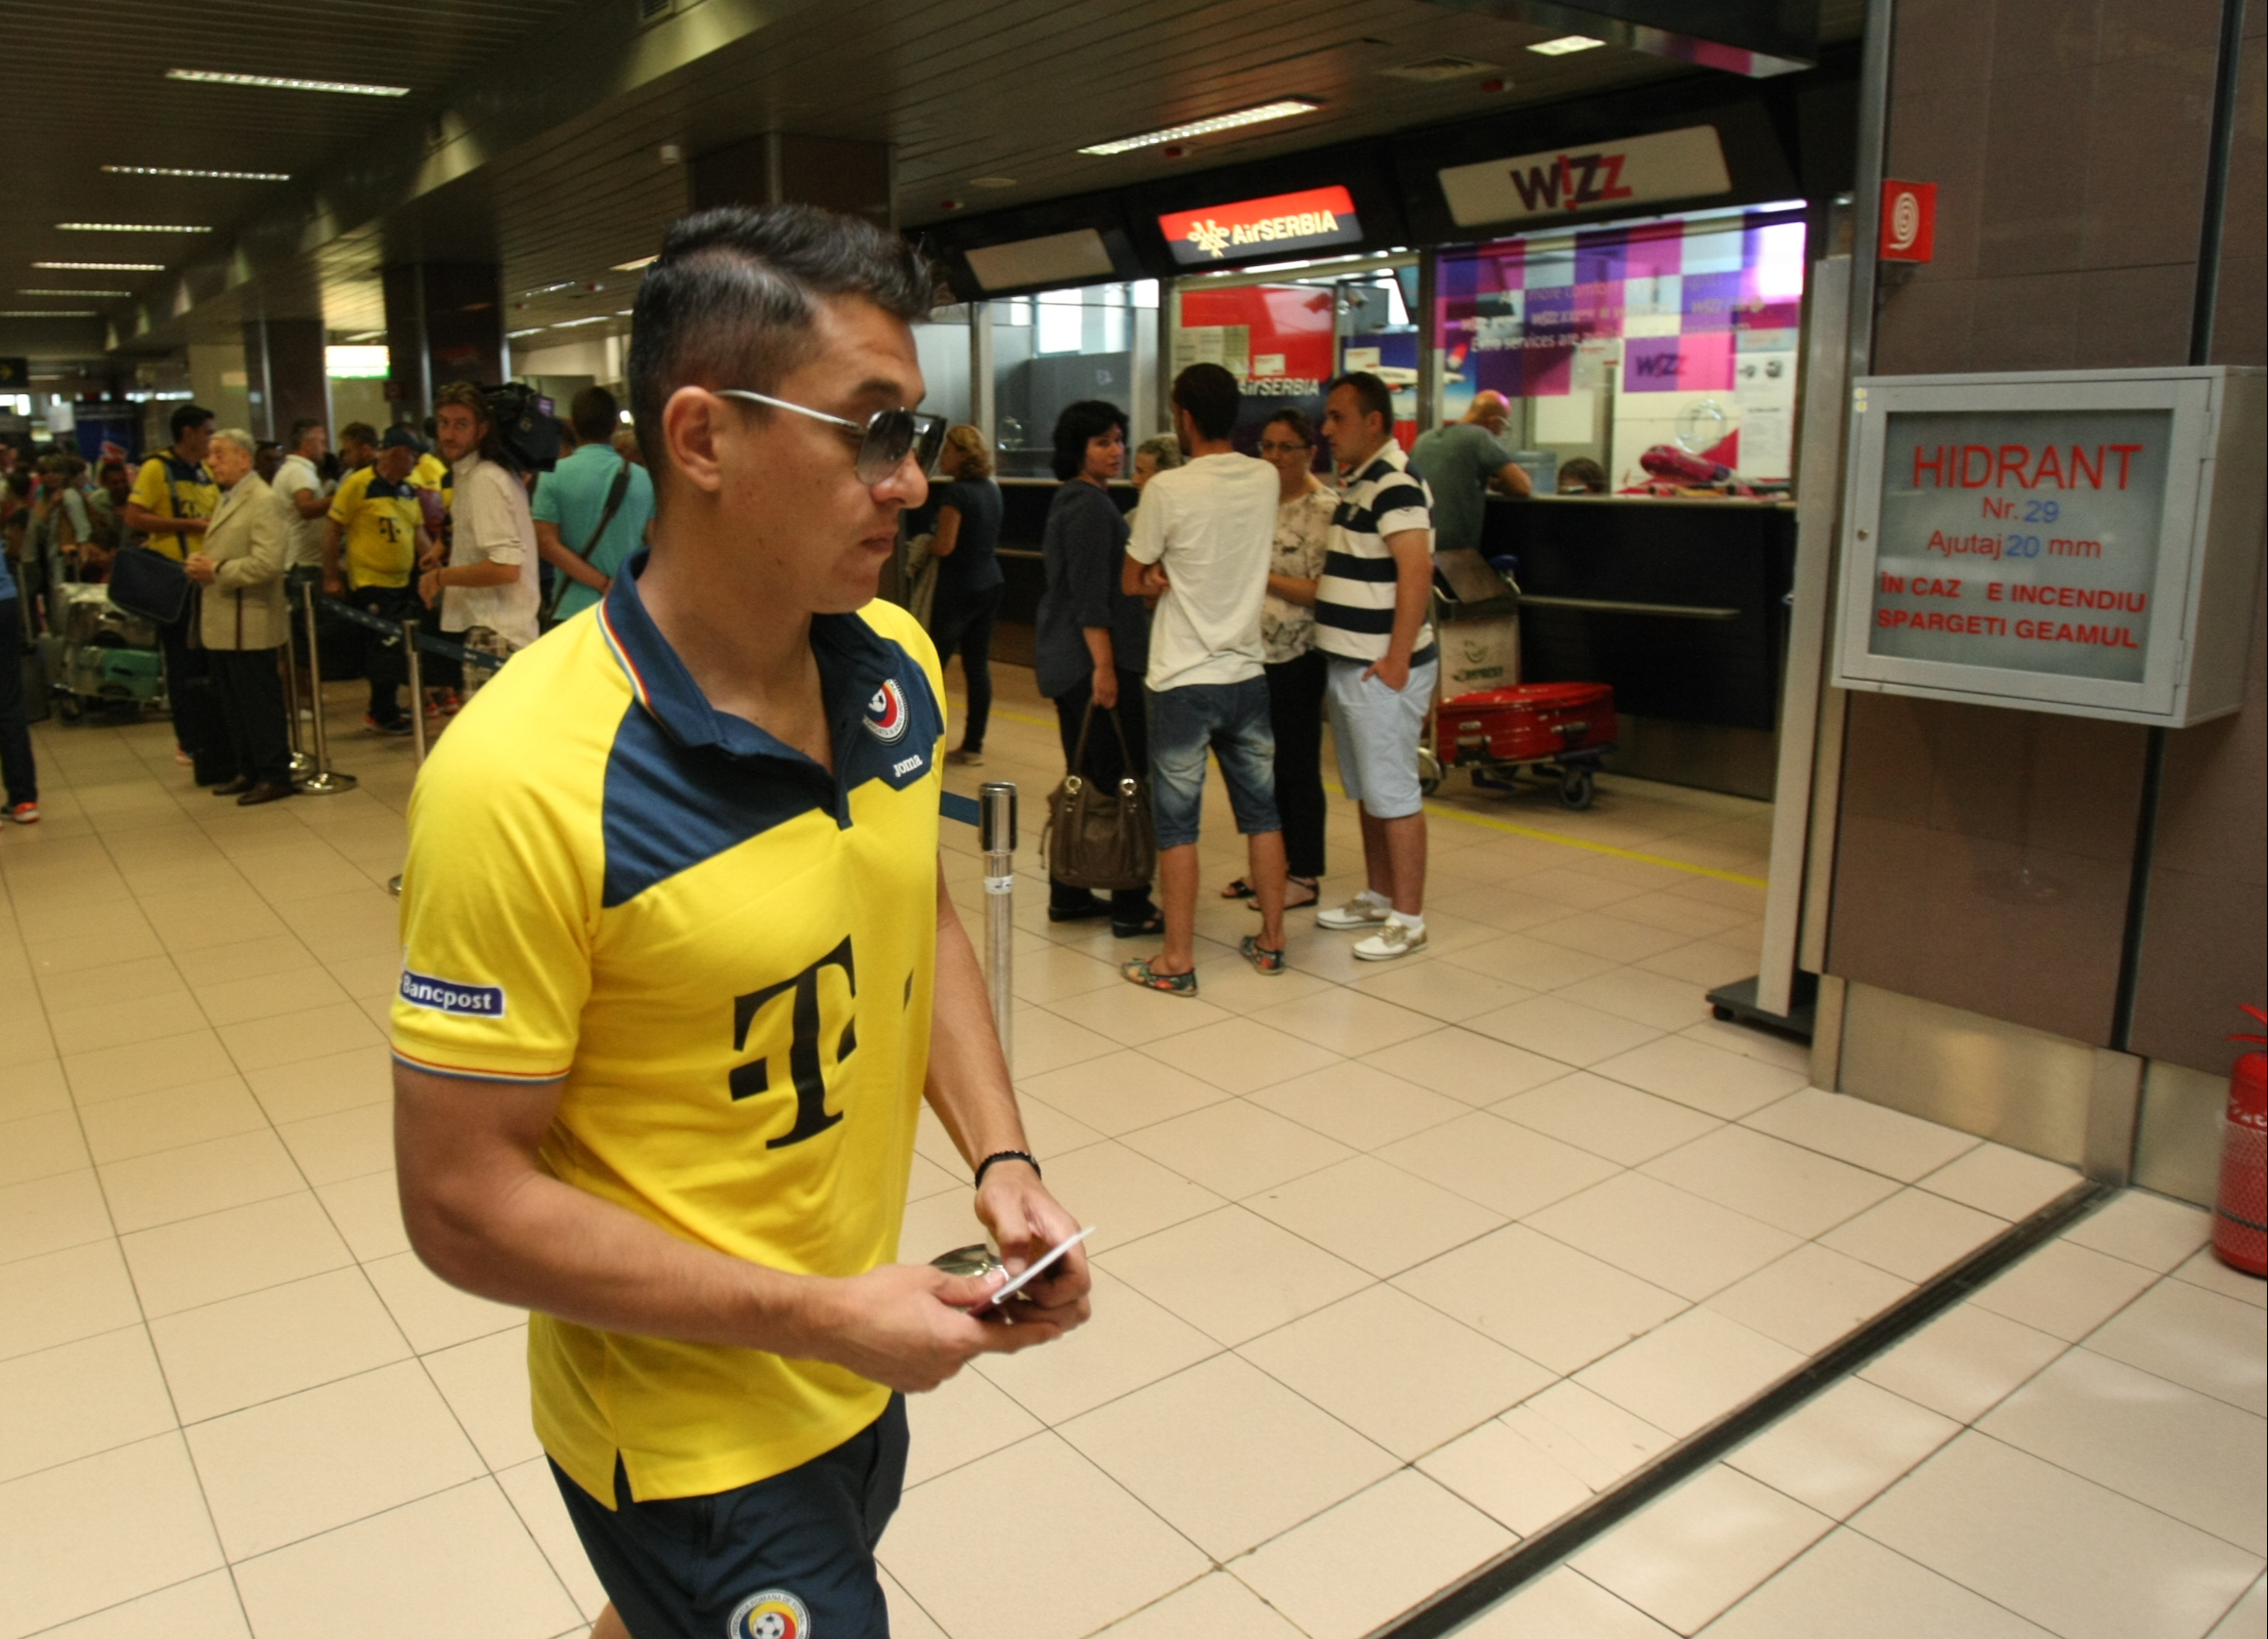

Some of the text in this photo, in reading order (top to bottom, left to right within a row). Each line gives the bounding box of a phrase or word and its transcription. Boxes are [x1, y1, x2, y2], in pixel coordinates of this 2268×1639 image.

[1232, 210, 1339, 245] AirSERBIA
[1913, 444, 2145, 491] HIDRANT
[1982, 496, 2060, 523] Nr. 29
[1928, 530, 2103, 561] Ajutaj 20 mm
[1911, 577, 1962, 599] CAZ
[2011, 584, 2147, 613] INCENDIU
[1878, 608, 2140, 649] SPARGETI GEAMUL
[402, 974, 492, 1011] Bancpost
[729, 934, 856, 1150] T
